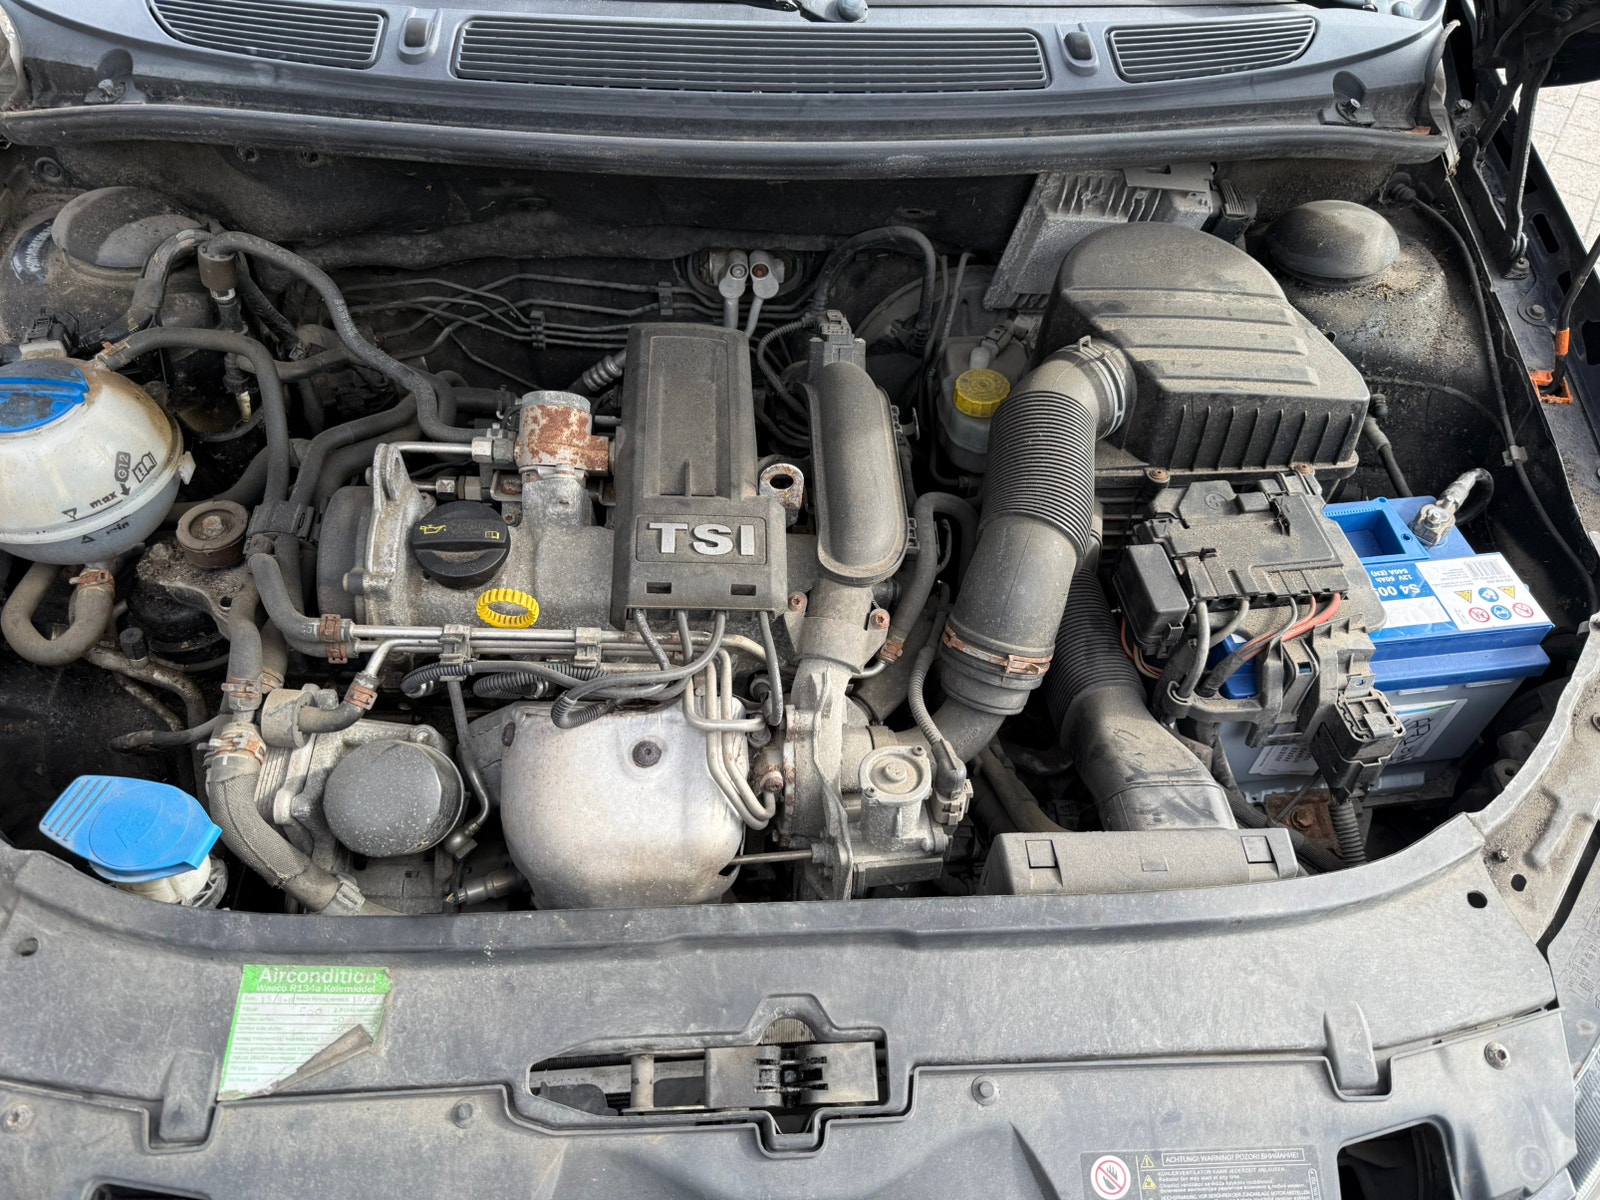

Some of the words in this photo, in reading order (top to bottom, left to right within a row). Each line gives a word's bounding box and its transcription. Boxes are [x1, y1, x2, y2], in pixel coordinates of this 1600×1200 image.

[117, 454, 129, 477] G12
[89, 491, 118, 509] max
[647, 522, 756, 556] TSI
[1399, 583, 1421, 595] S4
[258, 967, 379, 985] Aircondition
[256, 984, 287, 993] Waeco
[290, 984, 321, 993] R134a
[1165, 1155, 1200, 1163] ACHTUNG!
[1200, 1154, 1234, 1162] WARNING!
